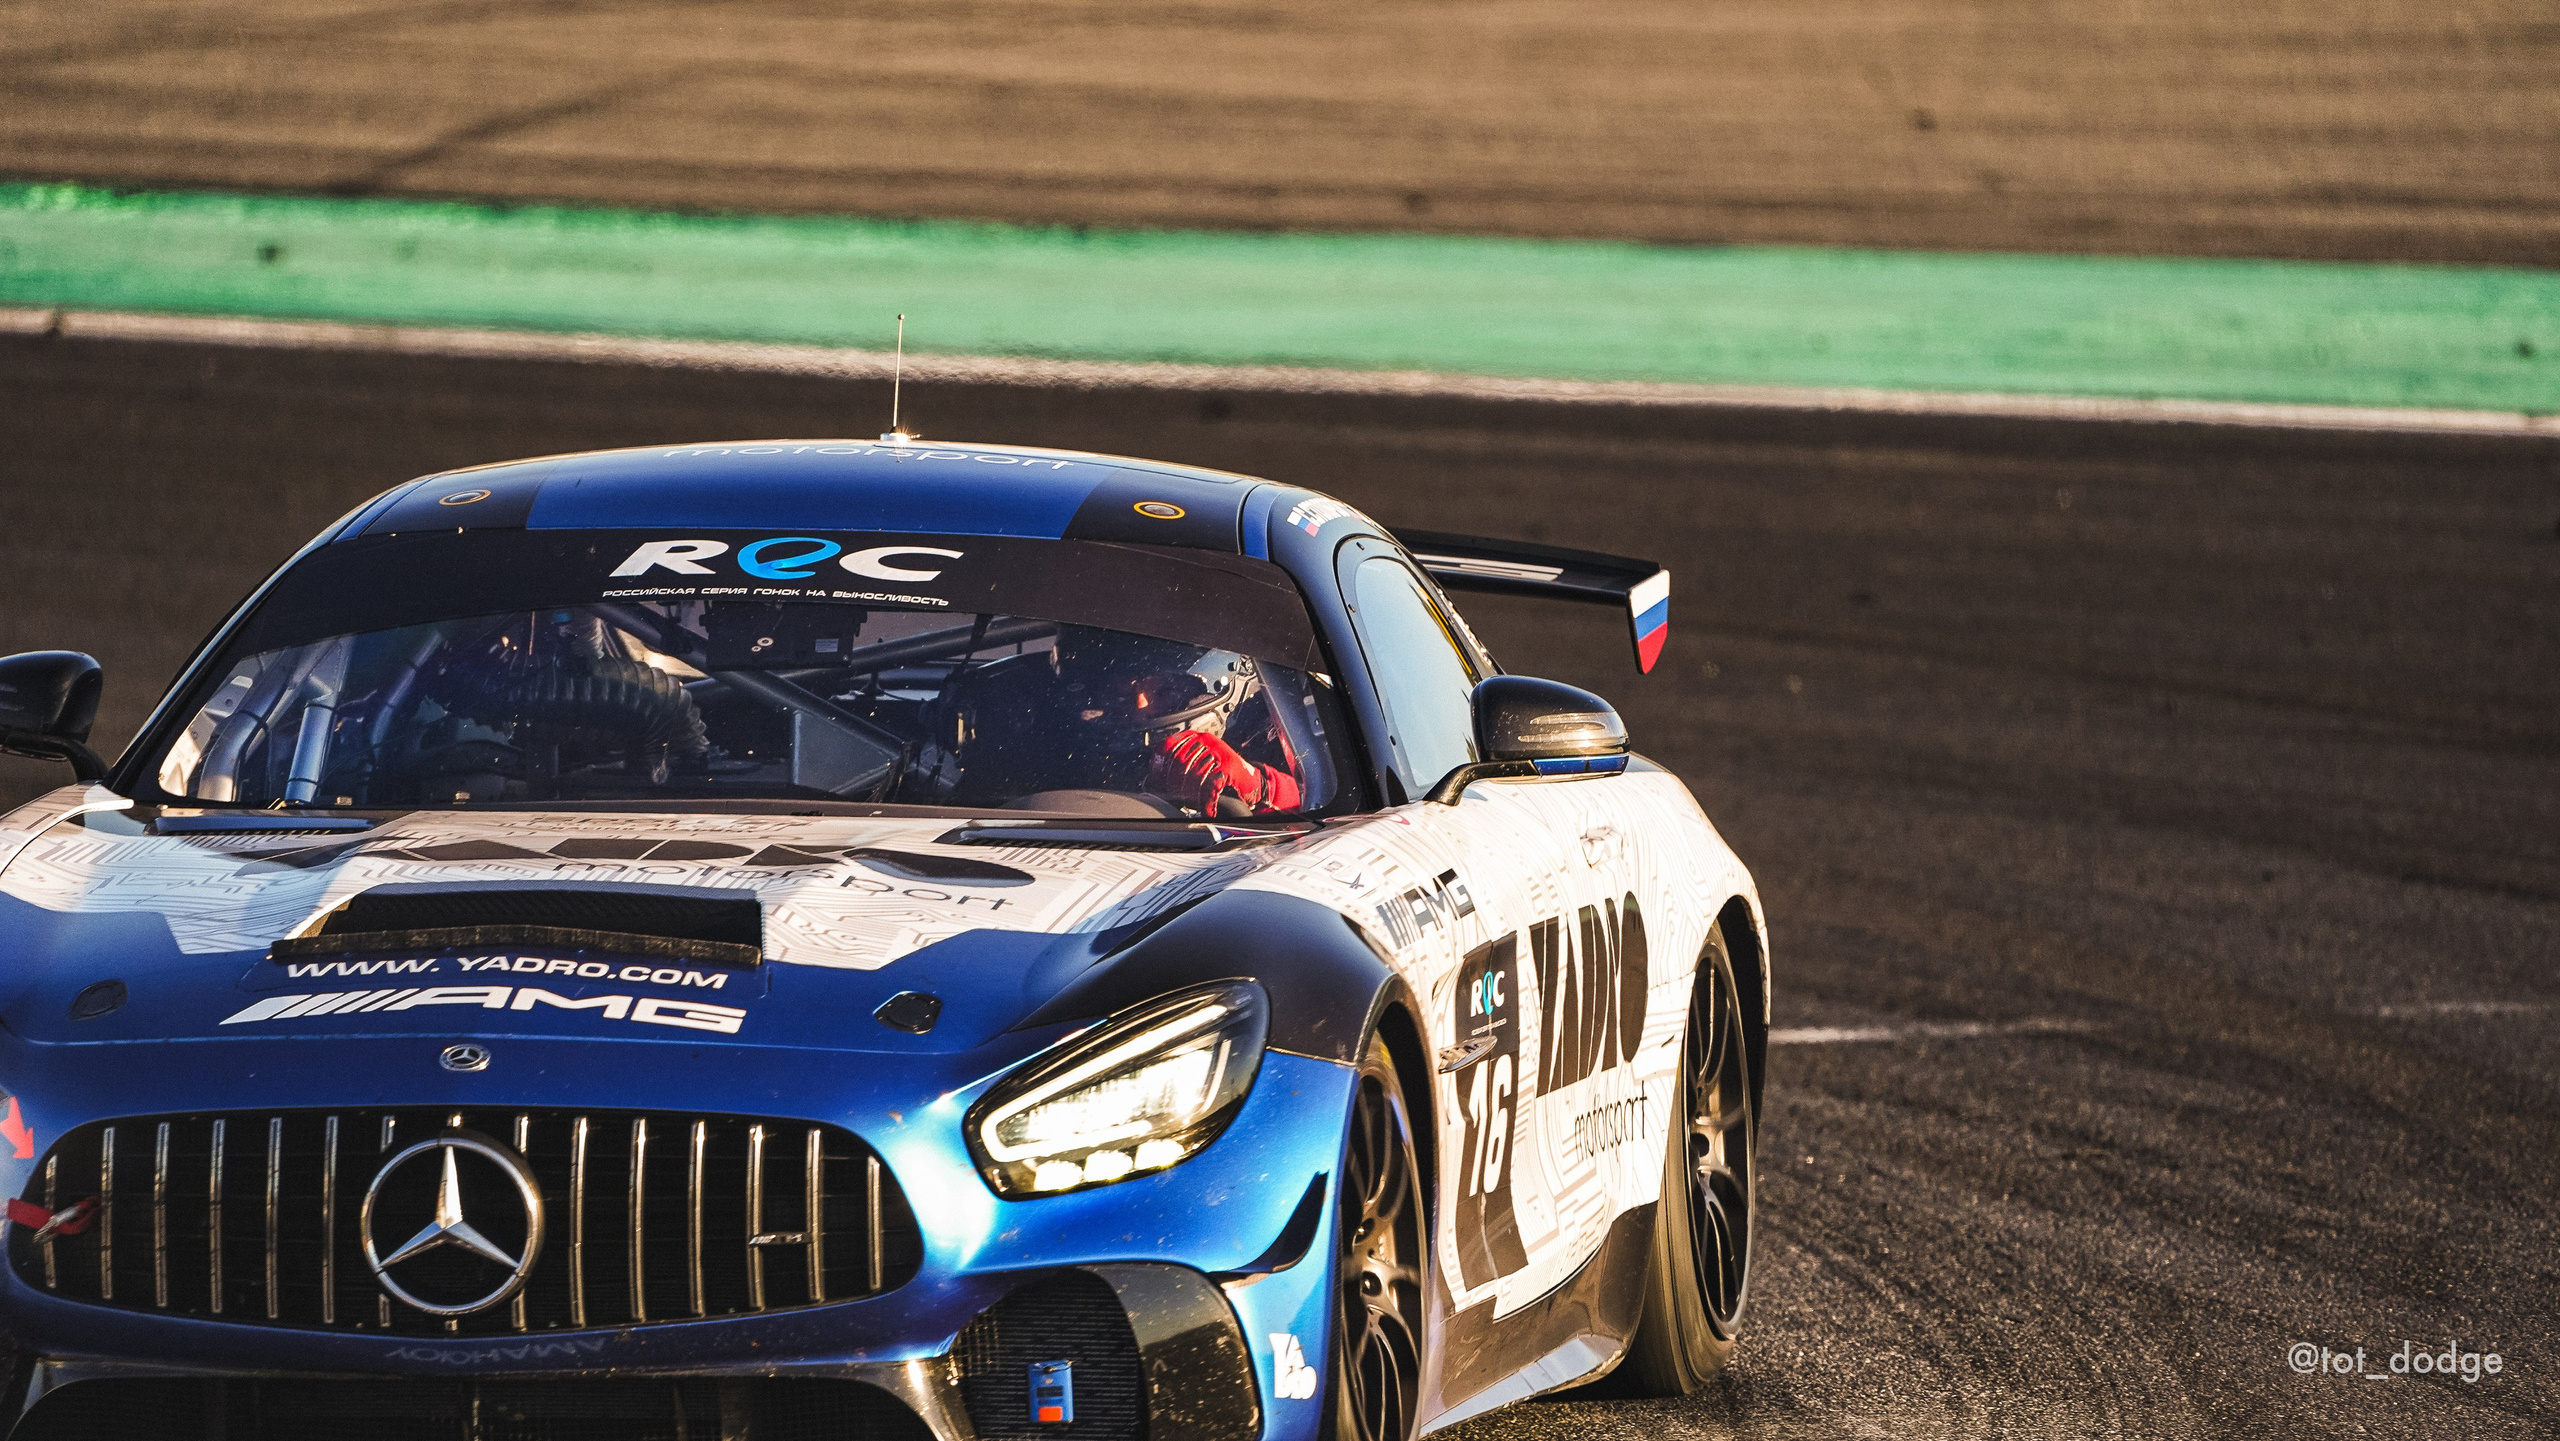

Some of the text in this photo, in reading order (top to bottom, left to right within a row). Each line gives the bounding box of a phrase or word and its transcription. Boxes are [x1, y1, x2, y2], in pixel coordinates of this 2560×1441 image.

[663, 445, 1074, 470] motorsport
[602, 587, 949, 606] РОССИЙСКАЯ СЕРИЯ ГОНОК НА ВЫНОСЛИВОСТЬ
[552, 862, 1014, 910] motorsport
[288, 956, 729, 990] WWW. YADRO.COM
[1529, 890, 1649, 1099] YADRO
[1468, 1053, 1513, 1197] 16
[1575, 1080, 1648, 1163] motorsport
